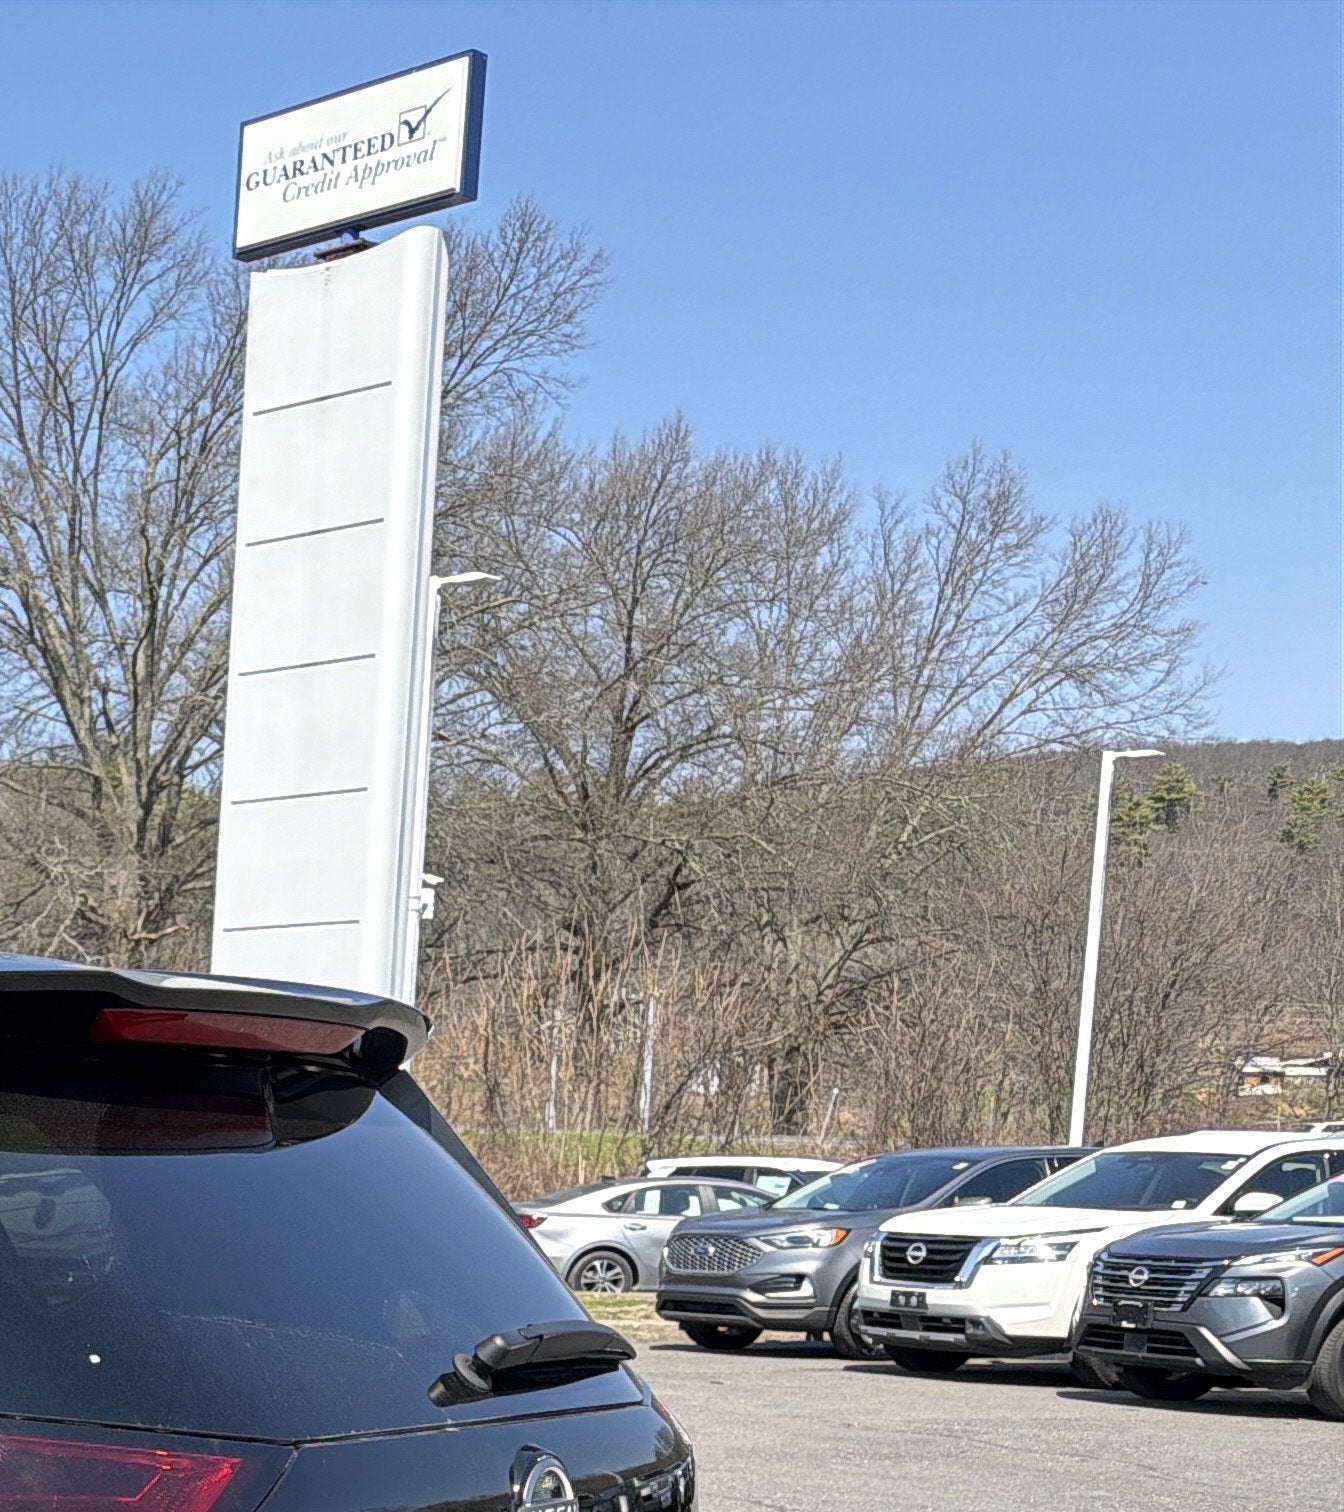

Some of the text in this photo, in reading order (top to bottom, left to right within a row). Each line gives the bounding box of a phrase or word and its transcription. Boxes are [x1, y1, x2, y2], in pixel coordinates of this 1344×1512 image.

[246, 132, 395, 192] GUARANTEED
[264, 131, 349, 166] Ask about our
[283, 139, 438, 203] Credit Approval
